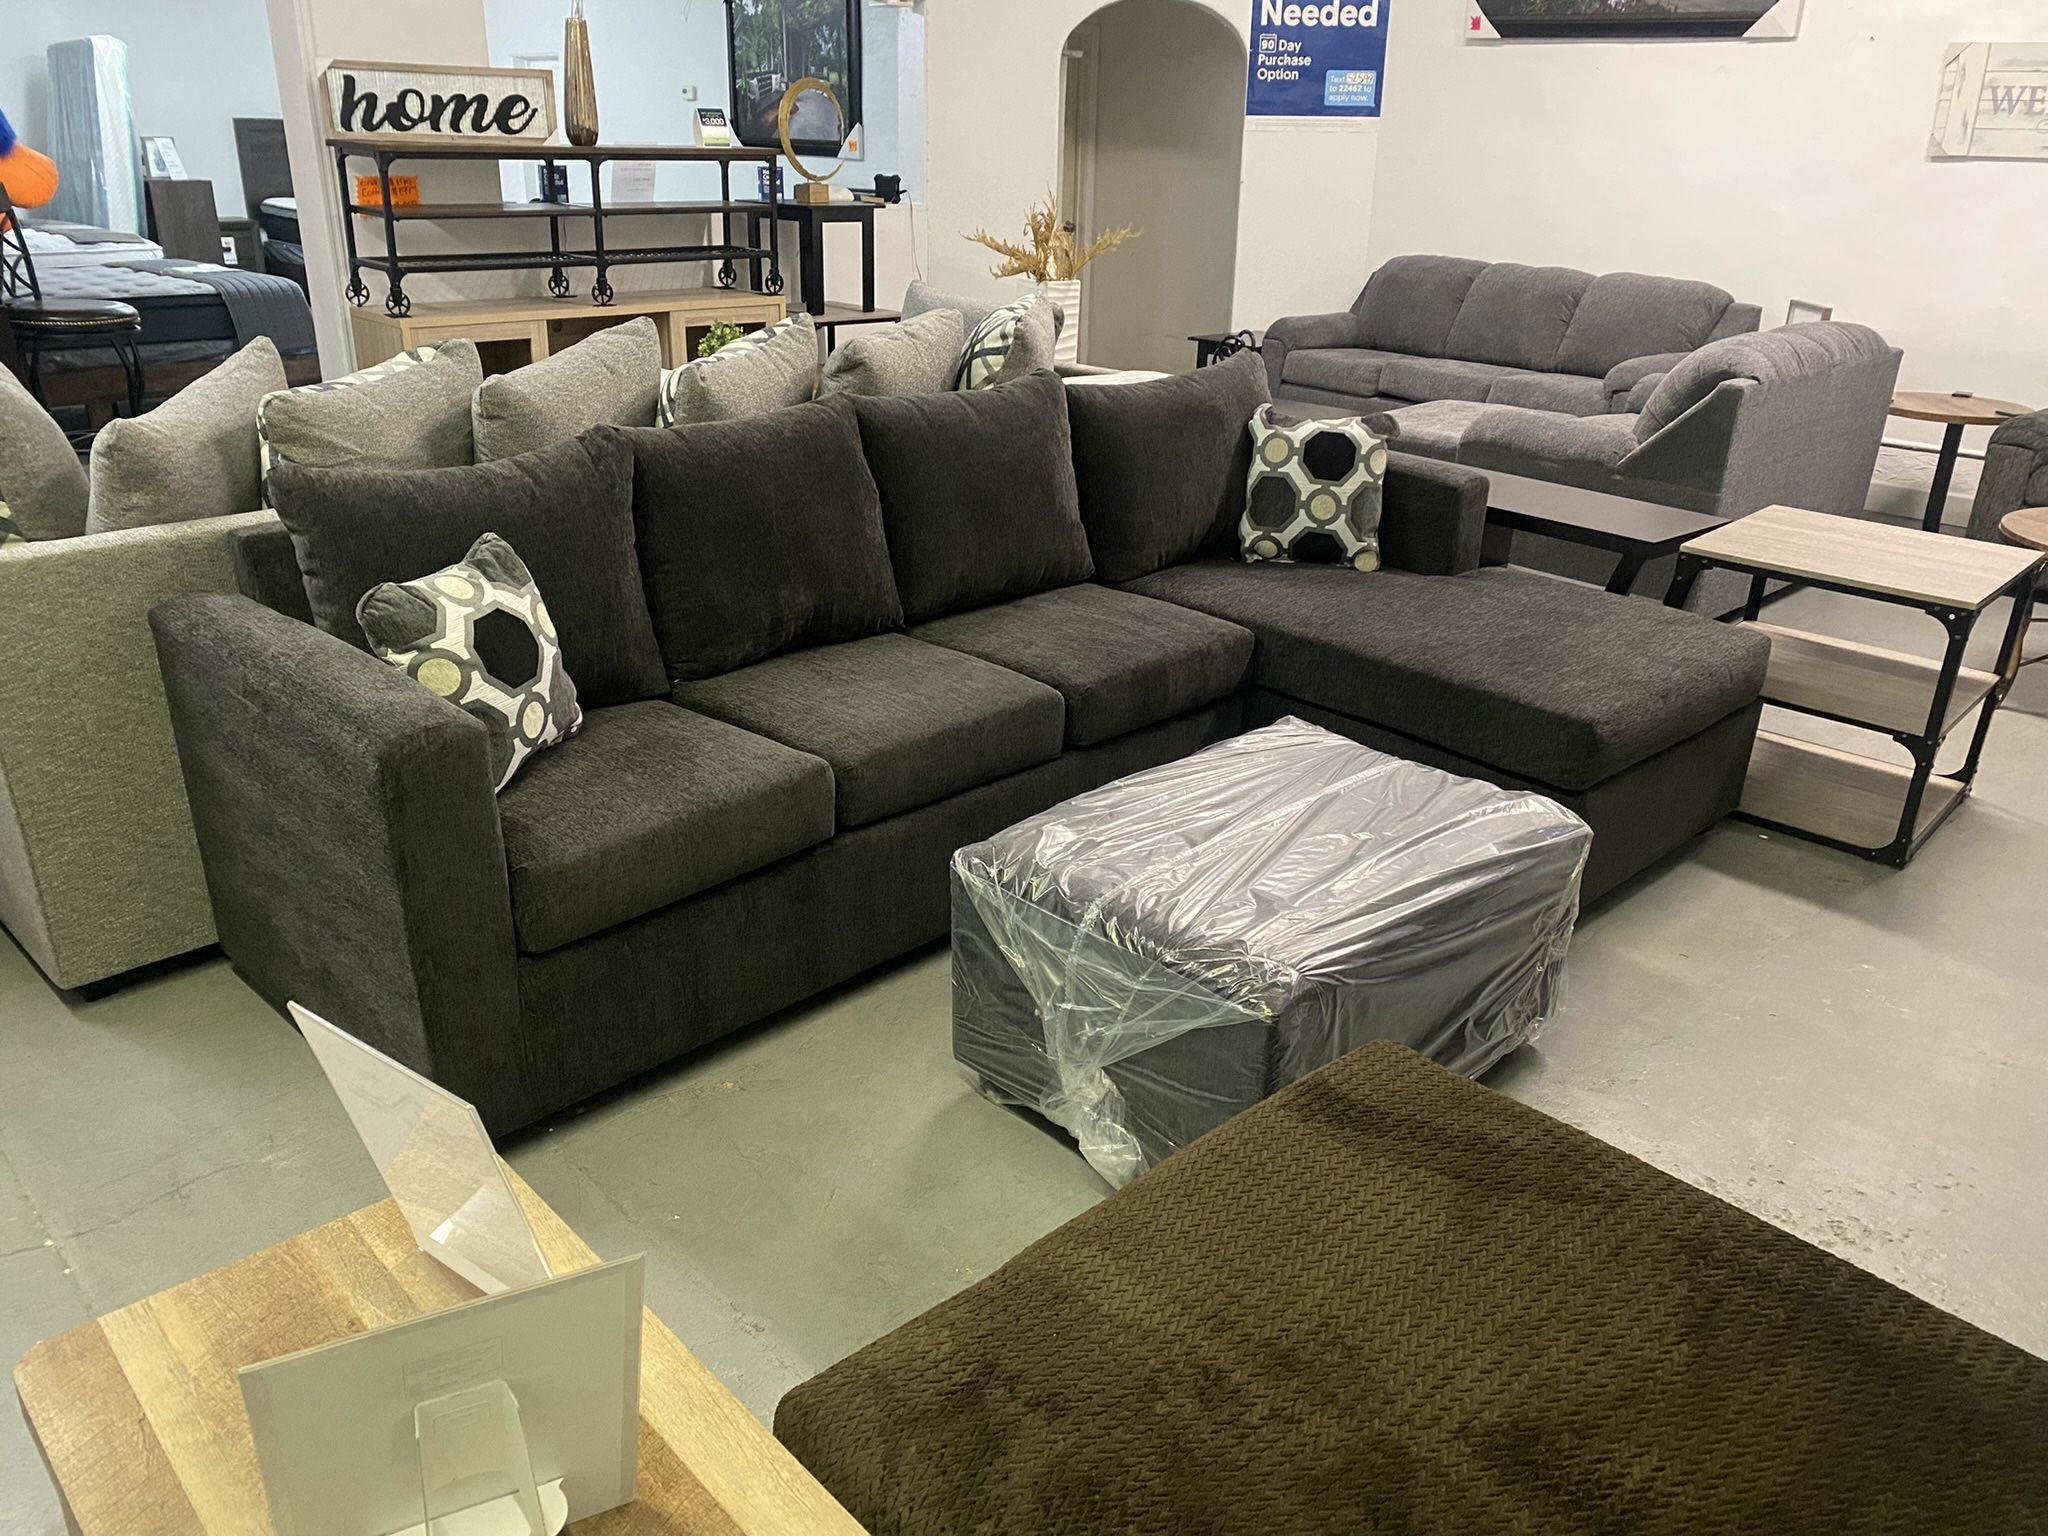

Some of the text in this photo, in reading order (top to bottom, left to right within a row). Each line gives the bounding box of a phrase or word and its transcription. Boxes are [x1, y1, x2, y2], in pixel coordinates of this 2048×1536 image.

[1260, 0, 1379, 27] Needed
[1261, 39, 1302, 53] 90 Day
[1257, 54, 1312, 67] Purchase
[1256, 68, 1300, 82] Option
[1330, 75, 1346, 83] Text
[1329, 84, 1372, 93] to 22462 to
[340, 74, 538, 135] home
[1328, 94, 1369, 104] apply now.
[1986, 85, 2048, 115] WE
